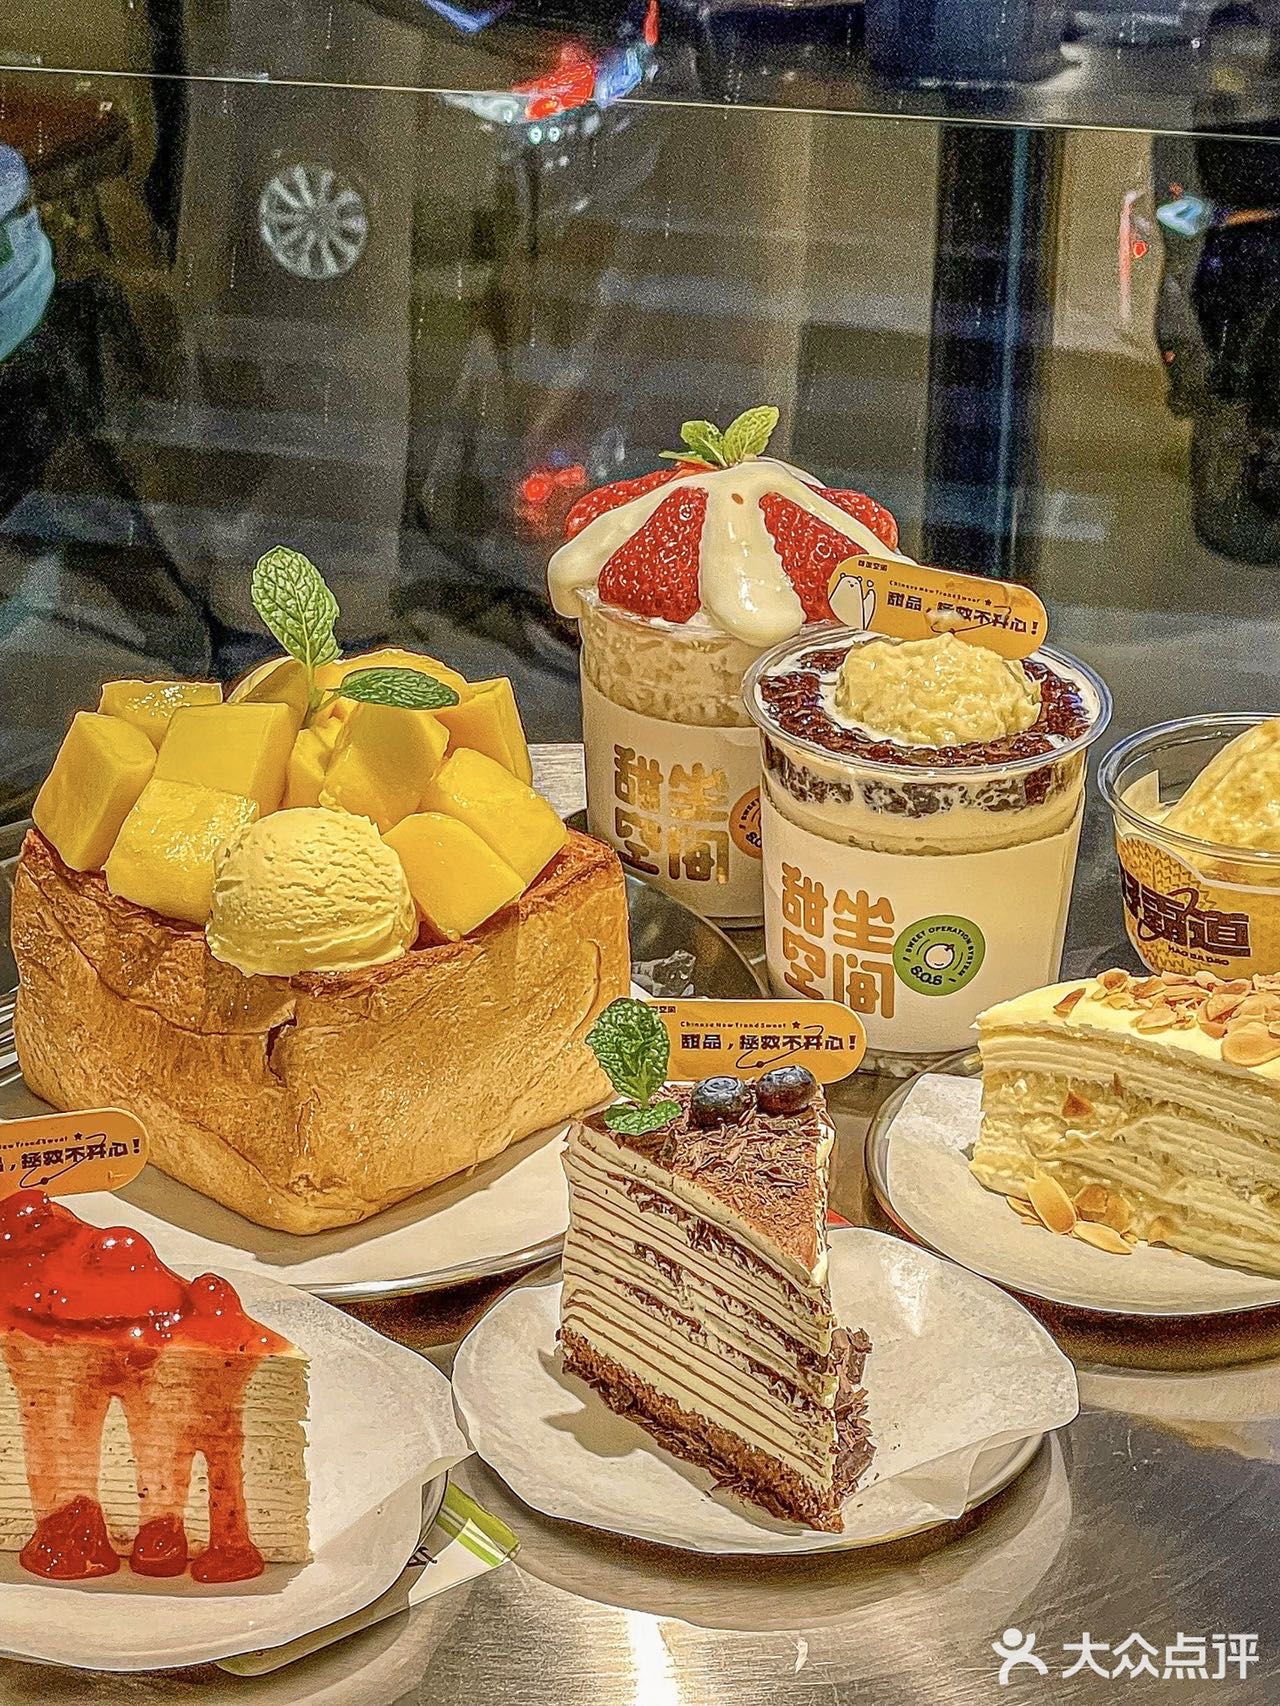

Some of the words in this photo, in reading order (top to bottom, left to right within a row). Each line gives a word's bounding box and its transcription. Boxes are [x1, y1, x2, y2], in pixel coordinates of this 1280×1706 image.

[905, 930, 927, 953] SWEET
[928, 925, 972, 945] OPERATION
[0, 1139, 140, 1173] ，拯救不开心！
